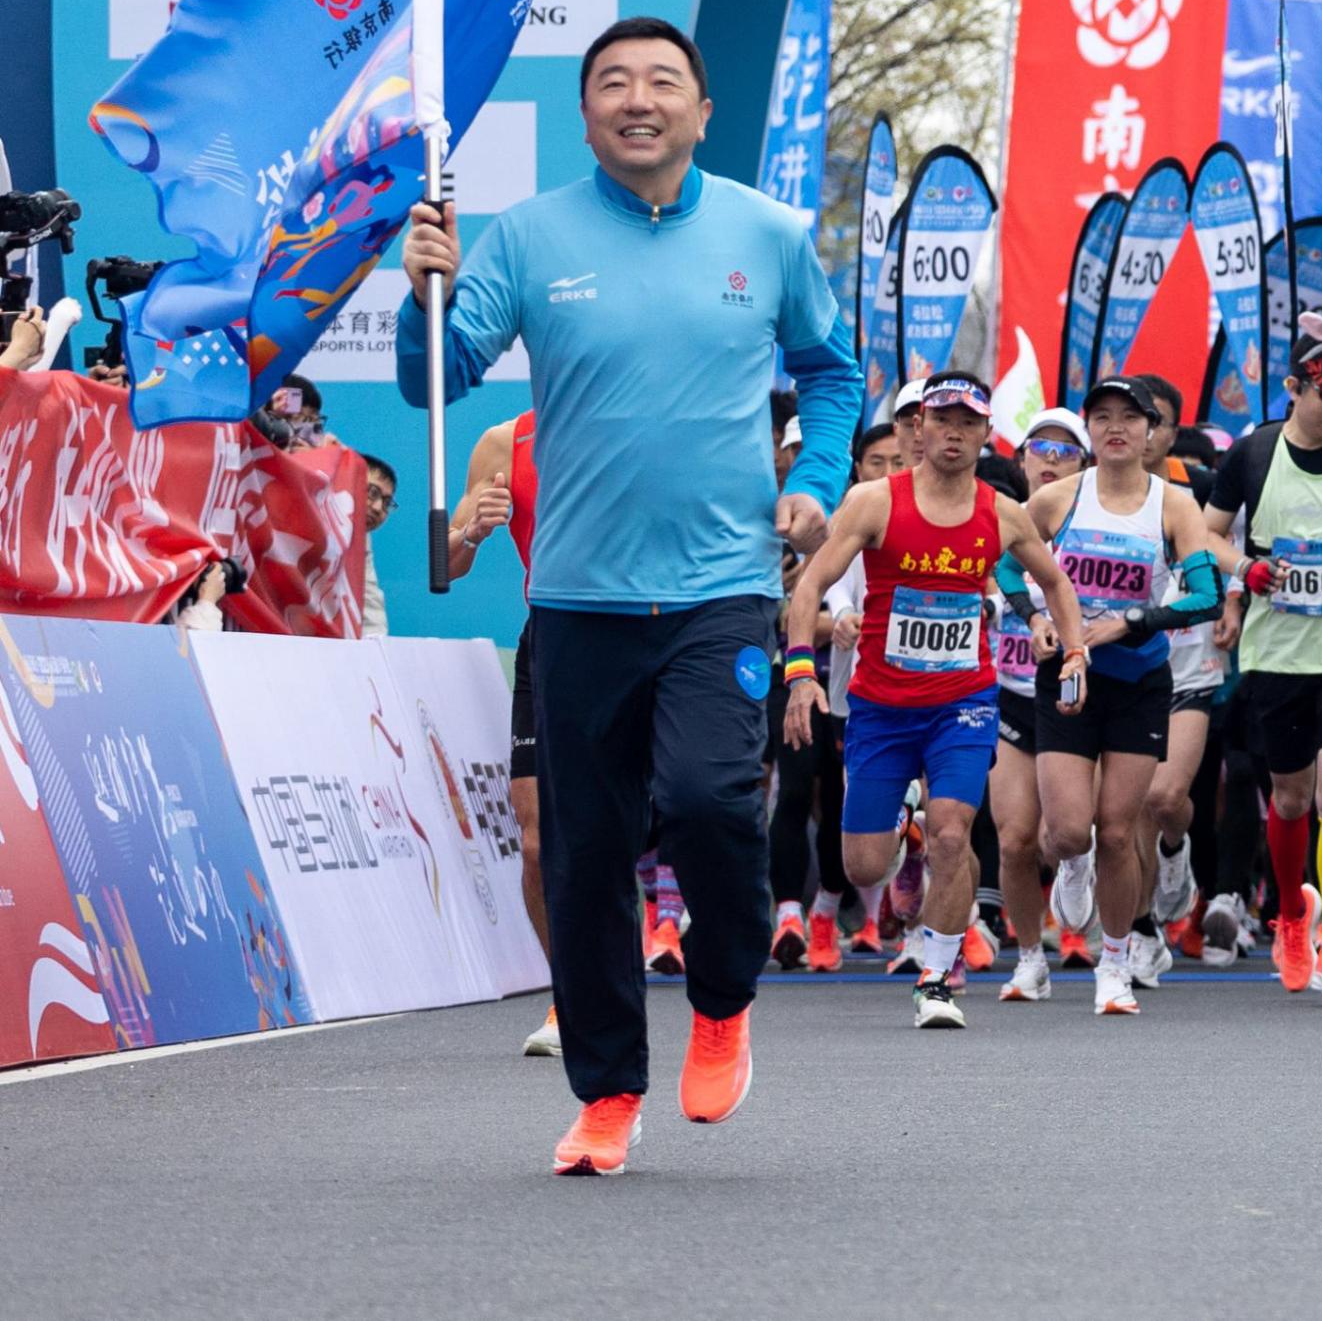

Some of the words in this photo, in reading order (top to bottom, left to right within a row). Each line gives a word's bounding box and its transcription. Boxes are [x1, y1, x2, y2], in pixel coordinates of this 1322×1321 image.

[913, 246, 970, 282] 6:00
[1215, 235, 1256, 277] 5:30
[549, 288, 598, 304] ERKE
[1063, 555, 1146, 593] 20023
[897, 618, 973, 652] 10082
